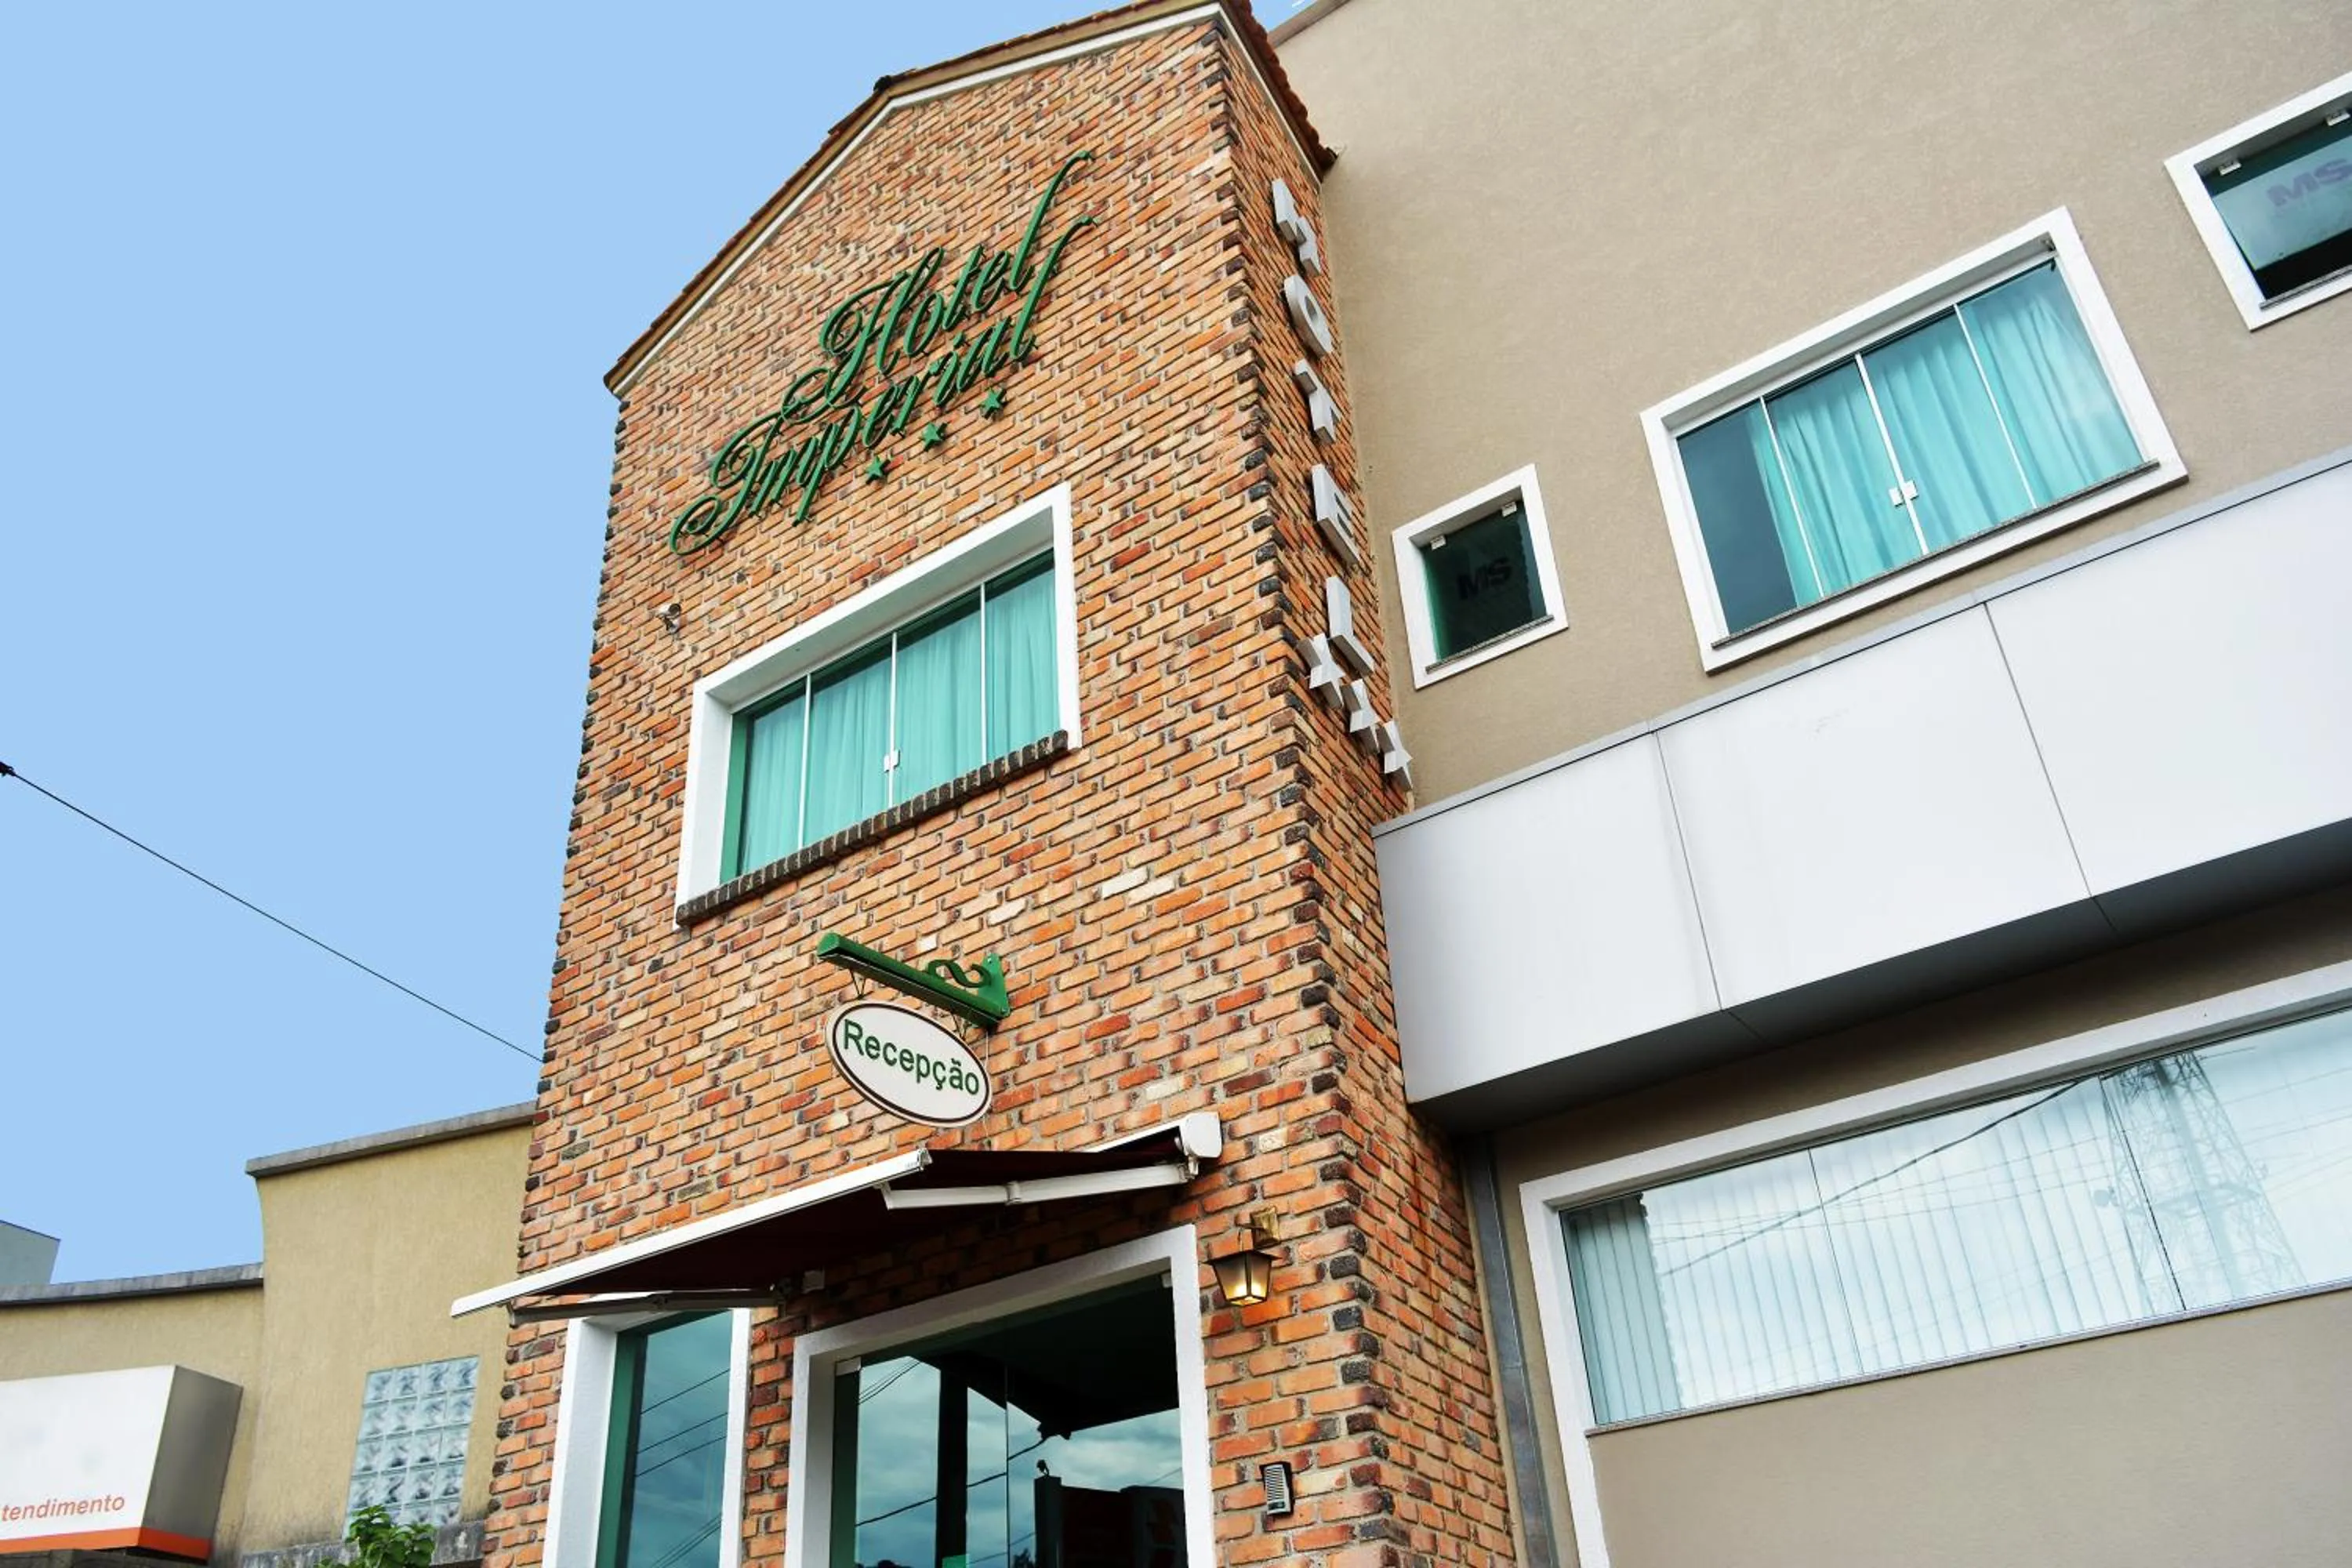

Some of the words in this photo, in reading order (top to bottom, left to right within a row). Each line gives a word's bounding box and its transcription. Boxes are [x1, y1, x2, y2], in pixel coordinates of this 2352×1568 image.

[670, 216, 1099, 556] Imperial
[780, 151, 1093, 424] Hotel
[843, 1018, 980, 1095] Recepção
